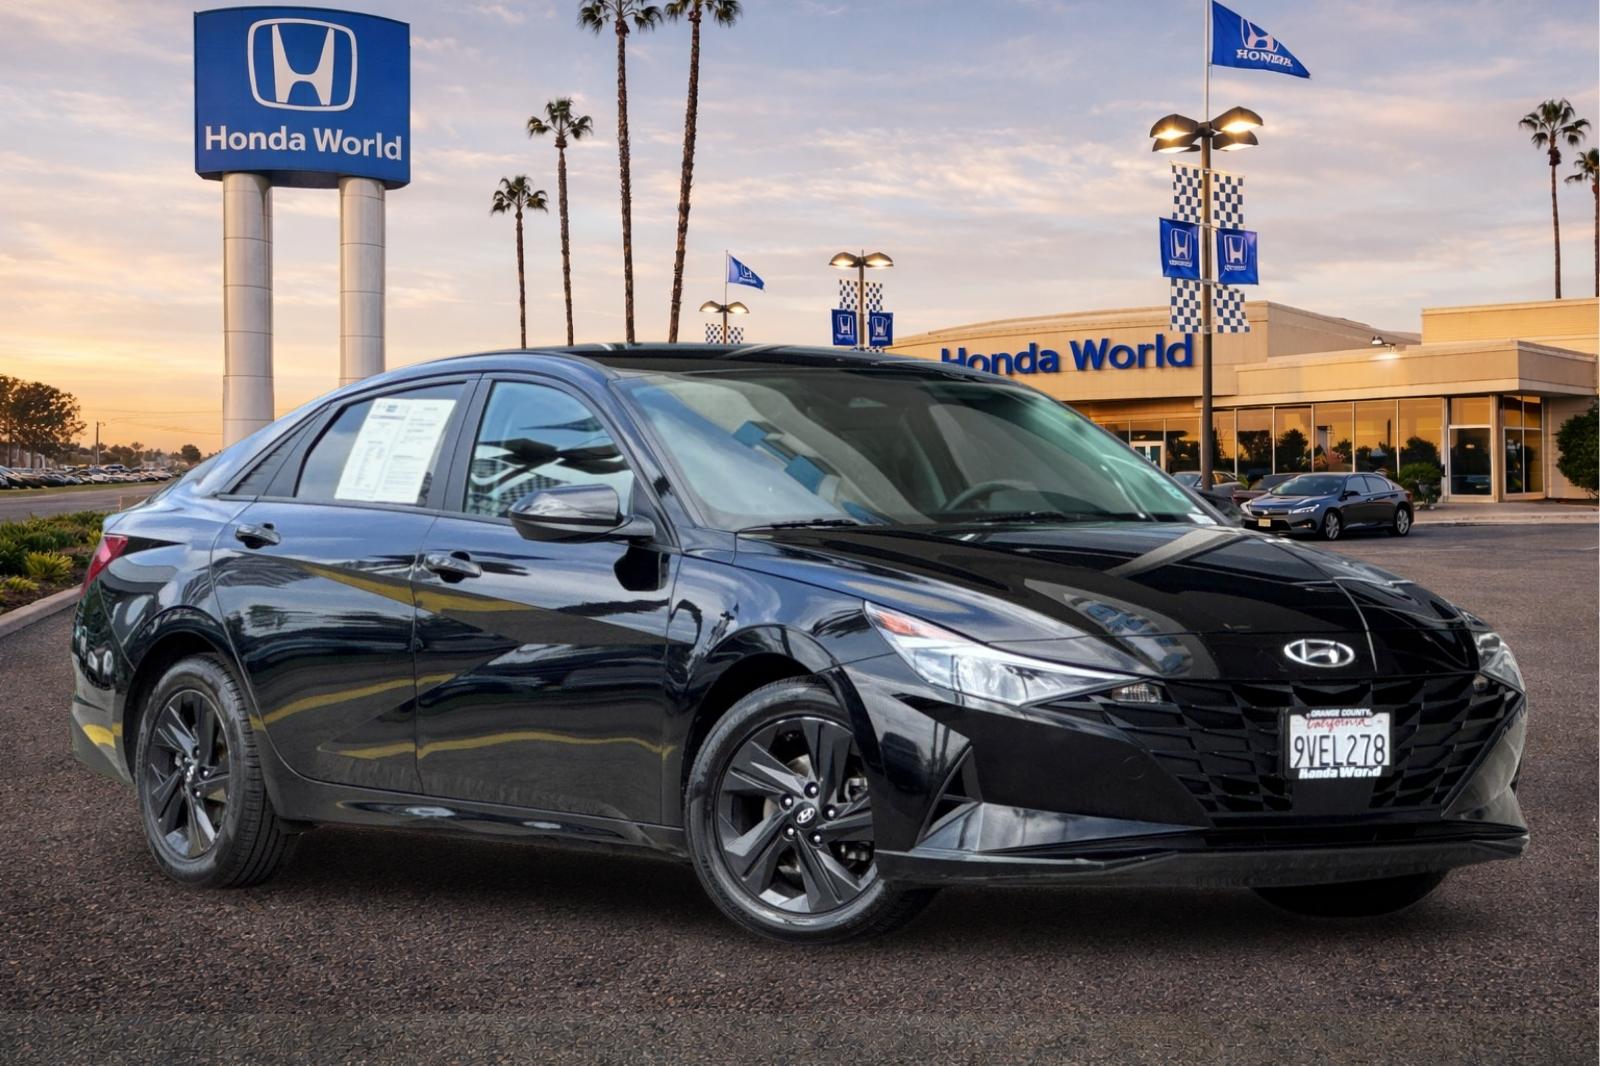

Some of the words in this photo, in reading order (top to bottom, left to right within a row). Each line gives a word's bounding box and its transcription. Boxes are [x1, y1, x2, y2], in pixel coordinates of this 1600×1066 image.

[205, 125, 306, 151] Honda
[313, 127, 402, 160] World
[941, 342, 1060, 374] Honda
[1069, 333, 1193, 371] World
[1311, 708, 1340, 718] ORANGE
[1341, 708, 1370, 717] COUNTY
[1294, 734, 1386, 768] 9VEL278
[1298, 767, 1338, 779] Honda
